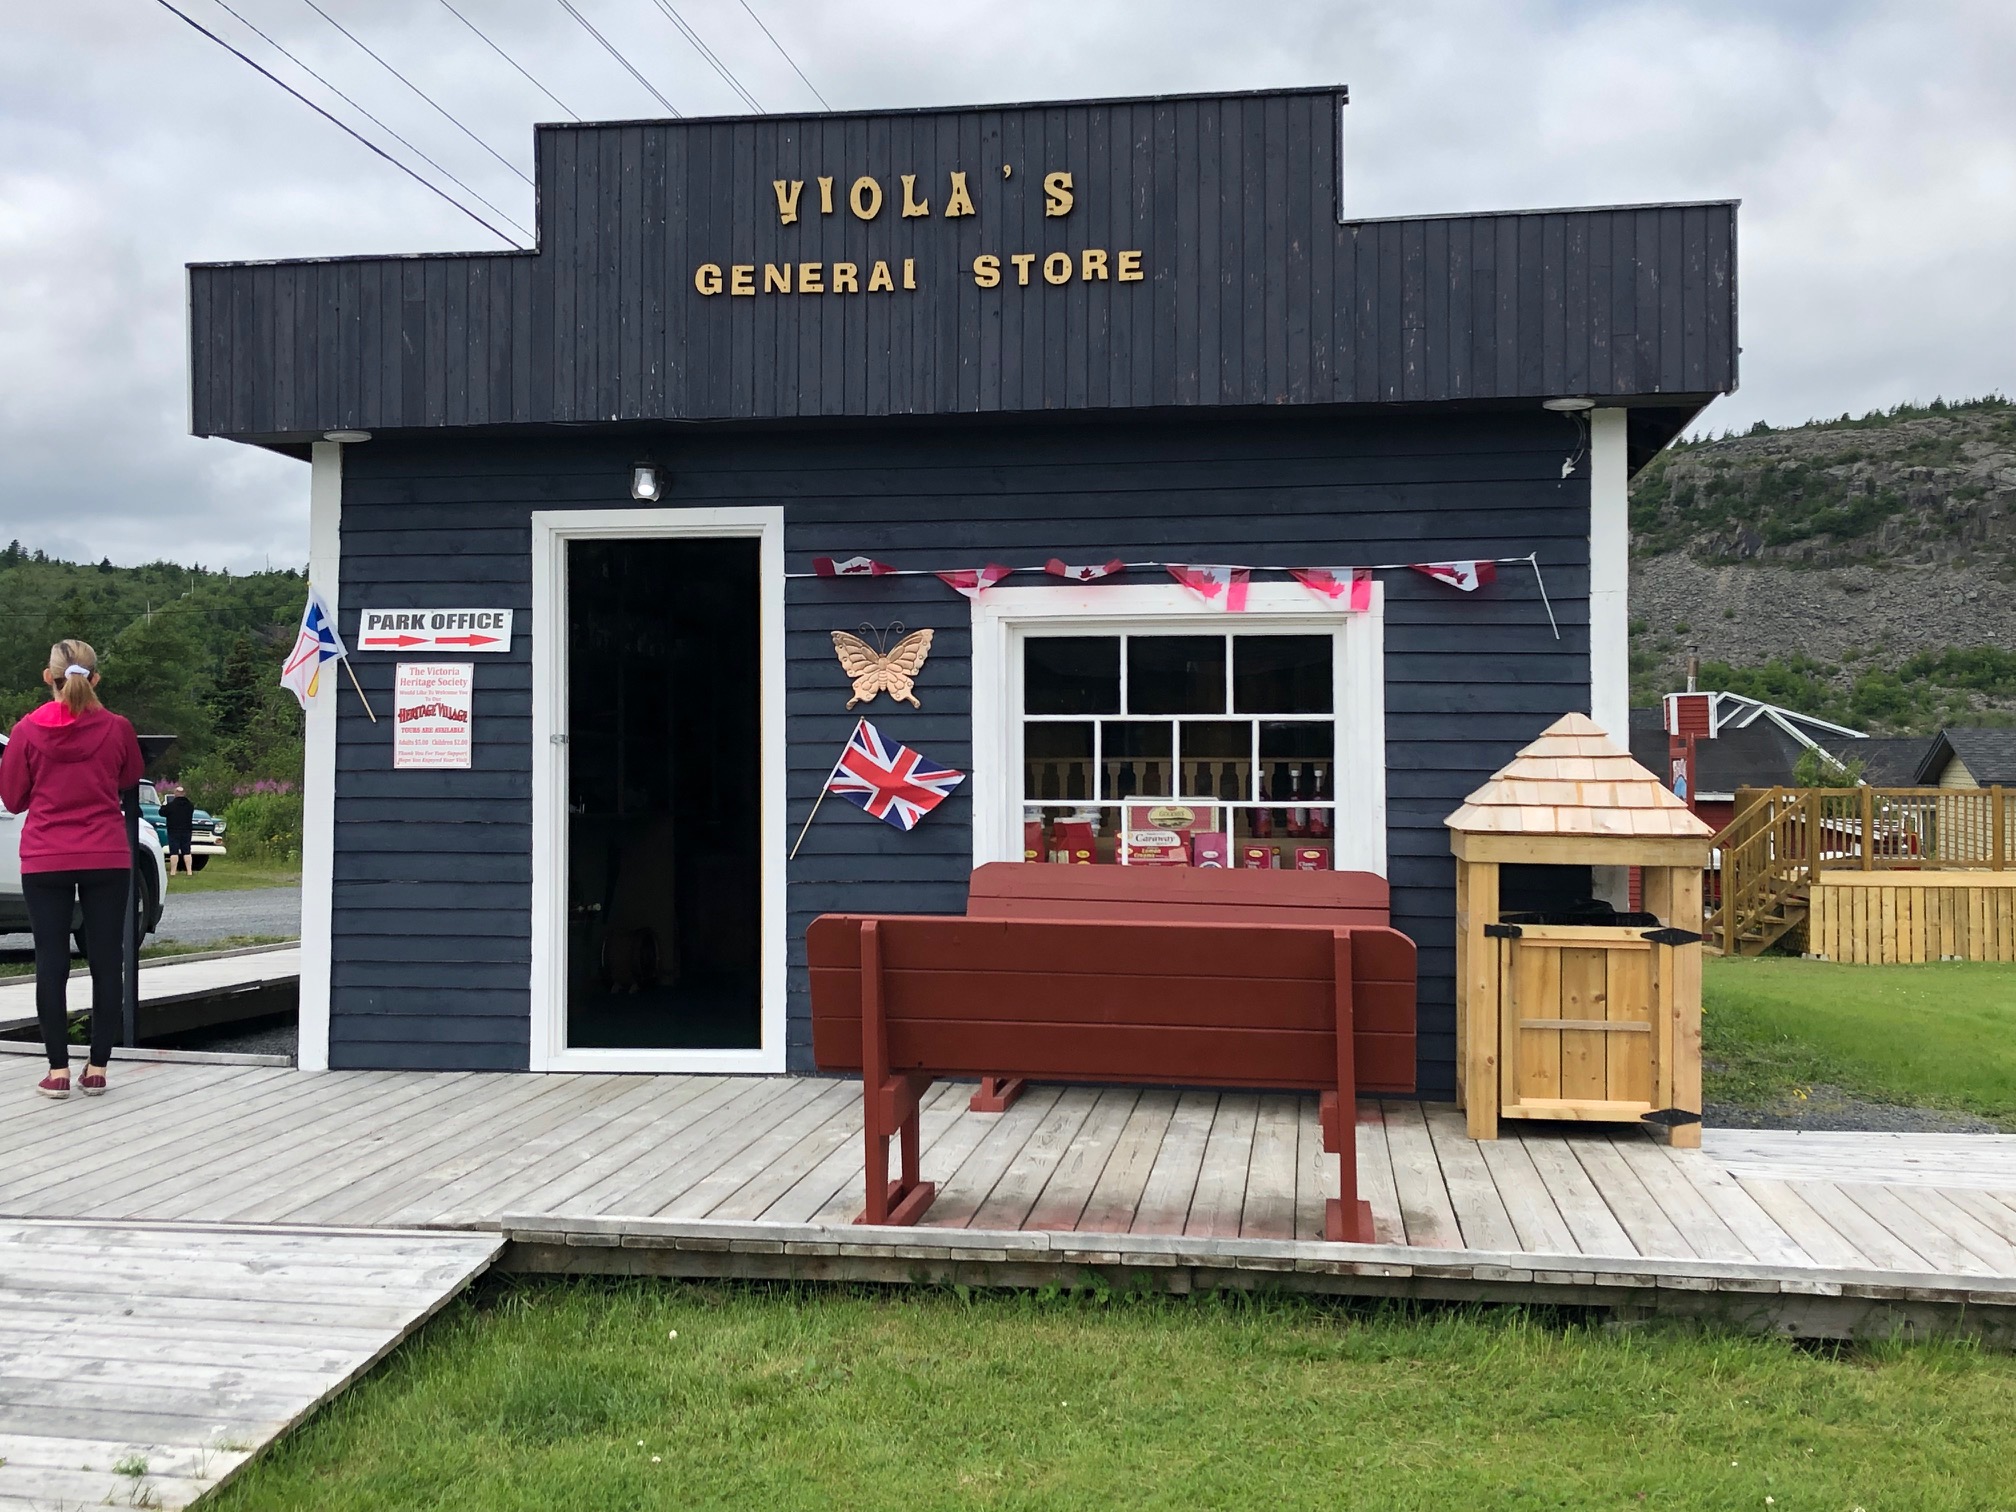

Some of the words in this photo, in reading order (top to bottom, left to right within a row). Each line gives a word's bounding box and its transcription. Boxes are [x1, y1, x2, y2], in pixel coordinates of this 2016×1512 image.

[773, 164, 1074, 225] VIOLA'S
[973, 249, 1144, 289] STORE
[367, 613, 426, 631] PARK
[431, 612, 504, 630] OFFICE
[409, 667, 425, 676] The
[427, 667, 460, 676] Victoria
[400, 678, 436, 688] Heritage
[438, 677, 468, 688] Society
[398, 704, 437, 723] HERITAGE
[436, 703, 468, 723] VILLAGE
[1135, 834, 1175, 843] Caraway
